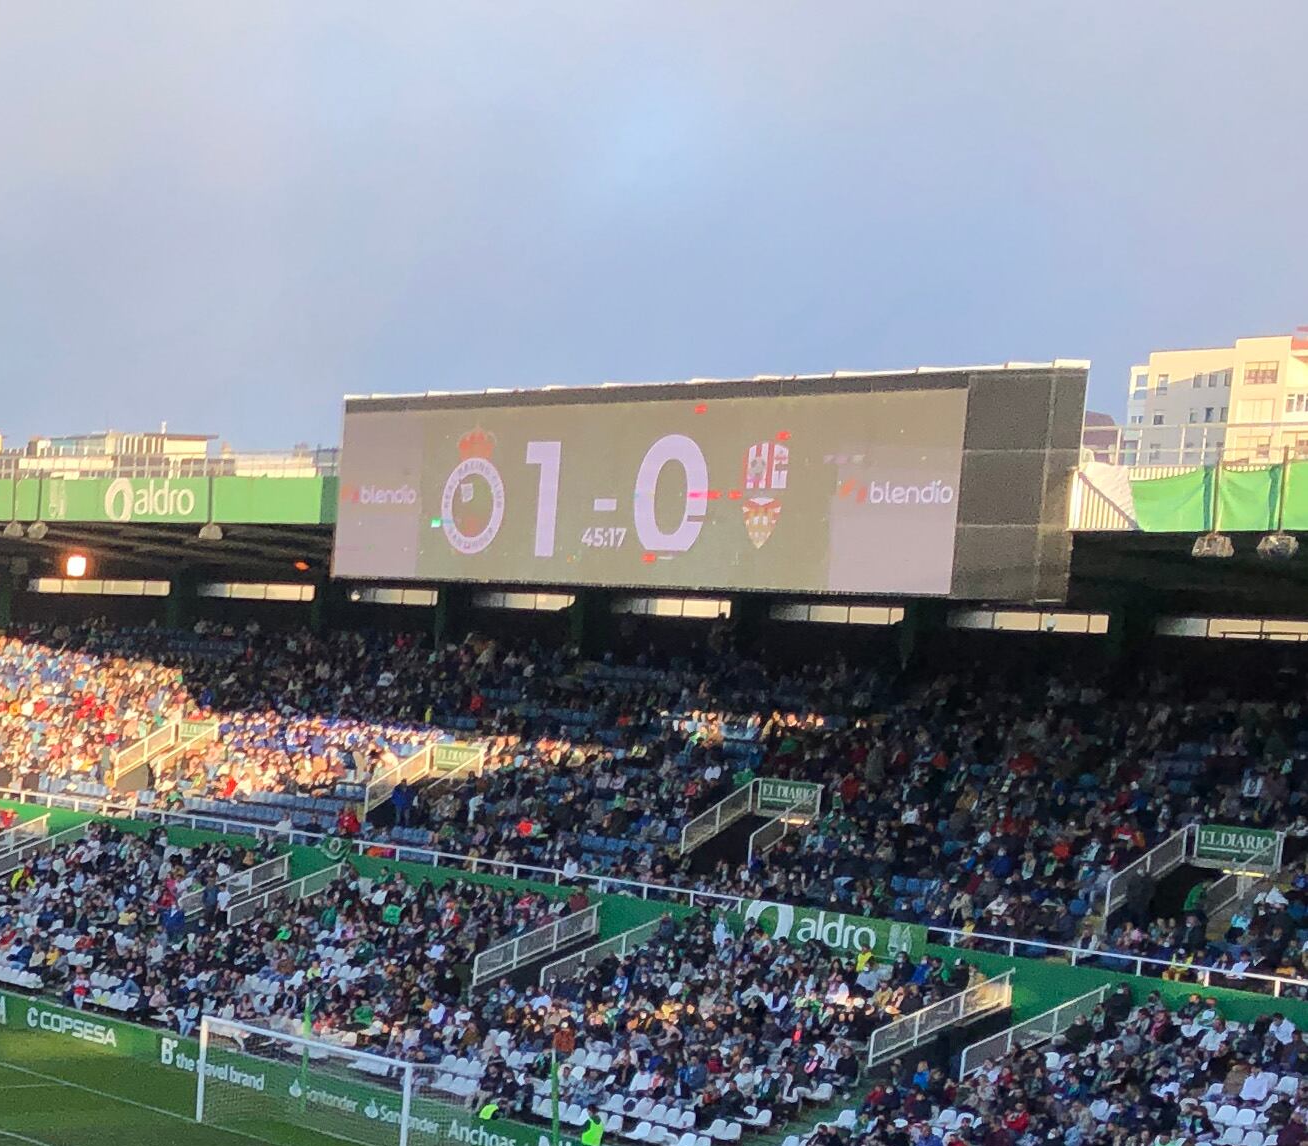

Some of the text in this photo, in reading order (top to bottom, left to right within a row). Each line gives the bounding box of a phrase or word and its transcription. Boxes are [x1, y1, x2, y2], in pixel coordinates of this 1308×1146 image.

[134, 480, 195, 516] aldro
[525, 441, 562, 557] 1
[633, 433, 709, 552] 0
[581, 527, 628, 549] 45:17
[762, 783, 816, 801] EL DIARIO
[1200, 831, 1273, 850] EL DIARIO
[796, 911, 878, 951] aldro
[39, 1010, 118, 1048] COPSESA
[175, 1053, 195, 1072] the
[229, 1065, 265, 1091] brand
